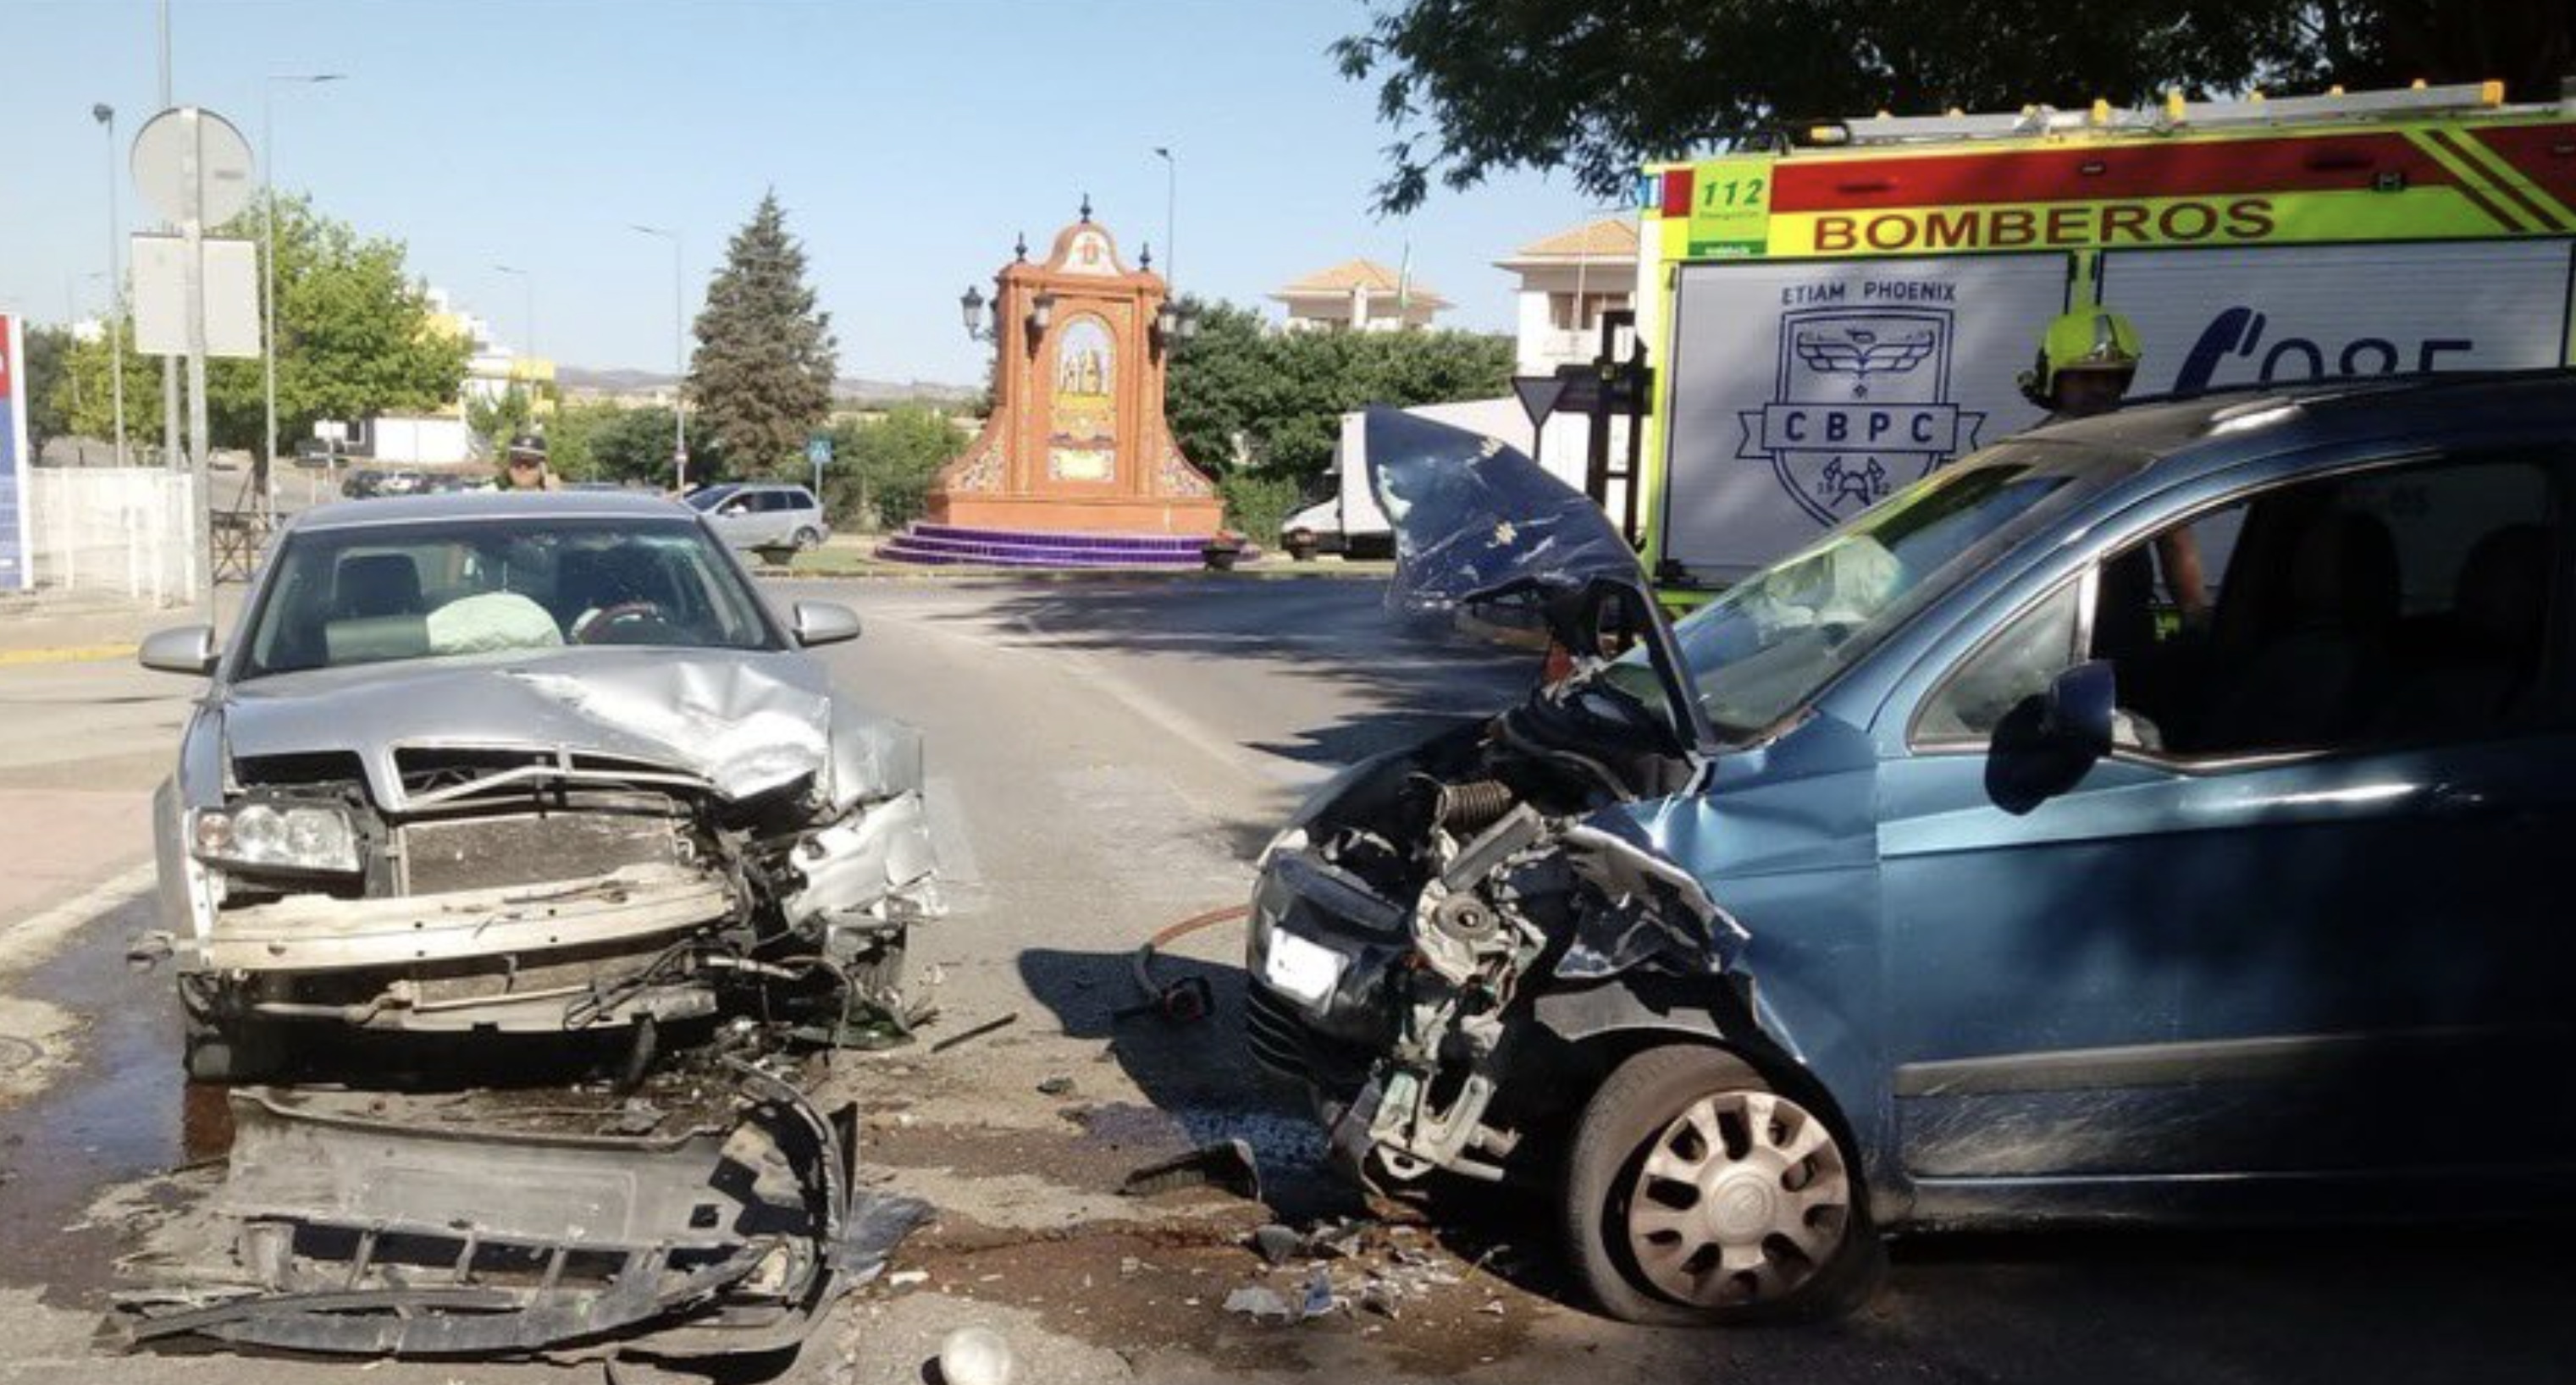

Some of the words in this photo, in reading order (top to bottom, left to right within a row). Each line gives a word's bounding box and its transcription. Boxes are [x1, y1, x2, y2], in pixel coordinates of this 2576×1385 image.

[1704, 179, 1763, 207] 112
[1814, 199, 2275, 251] BOMBEROS
[1781, 282, 1845, 305] ETIAM
[1864, 281, 1957, 301] PHOENIX
